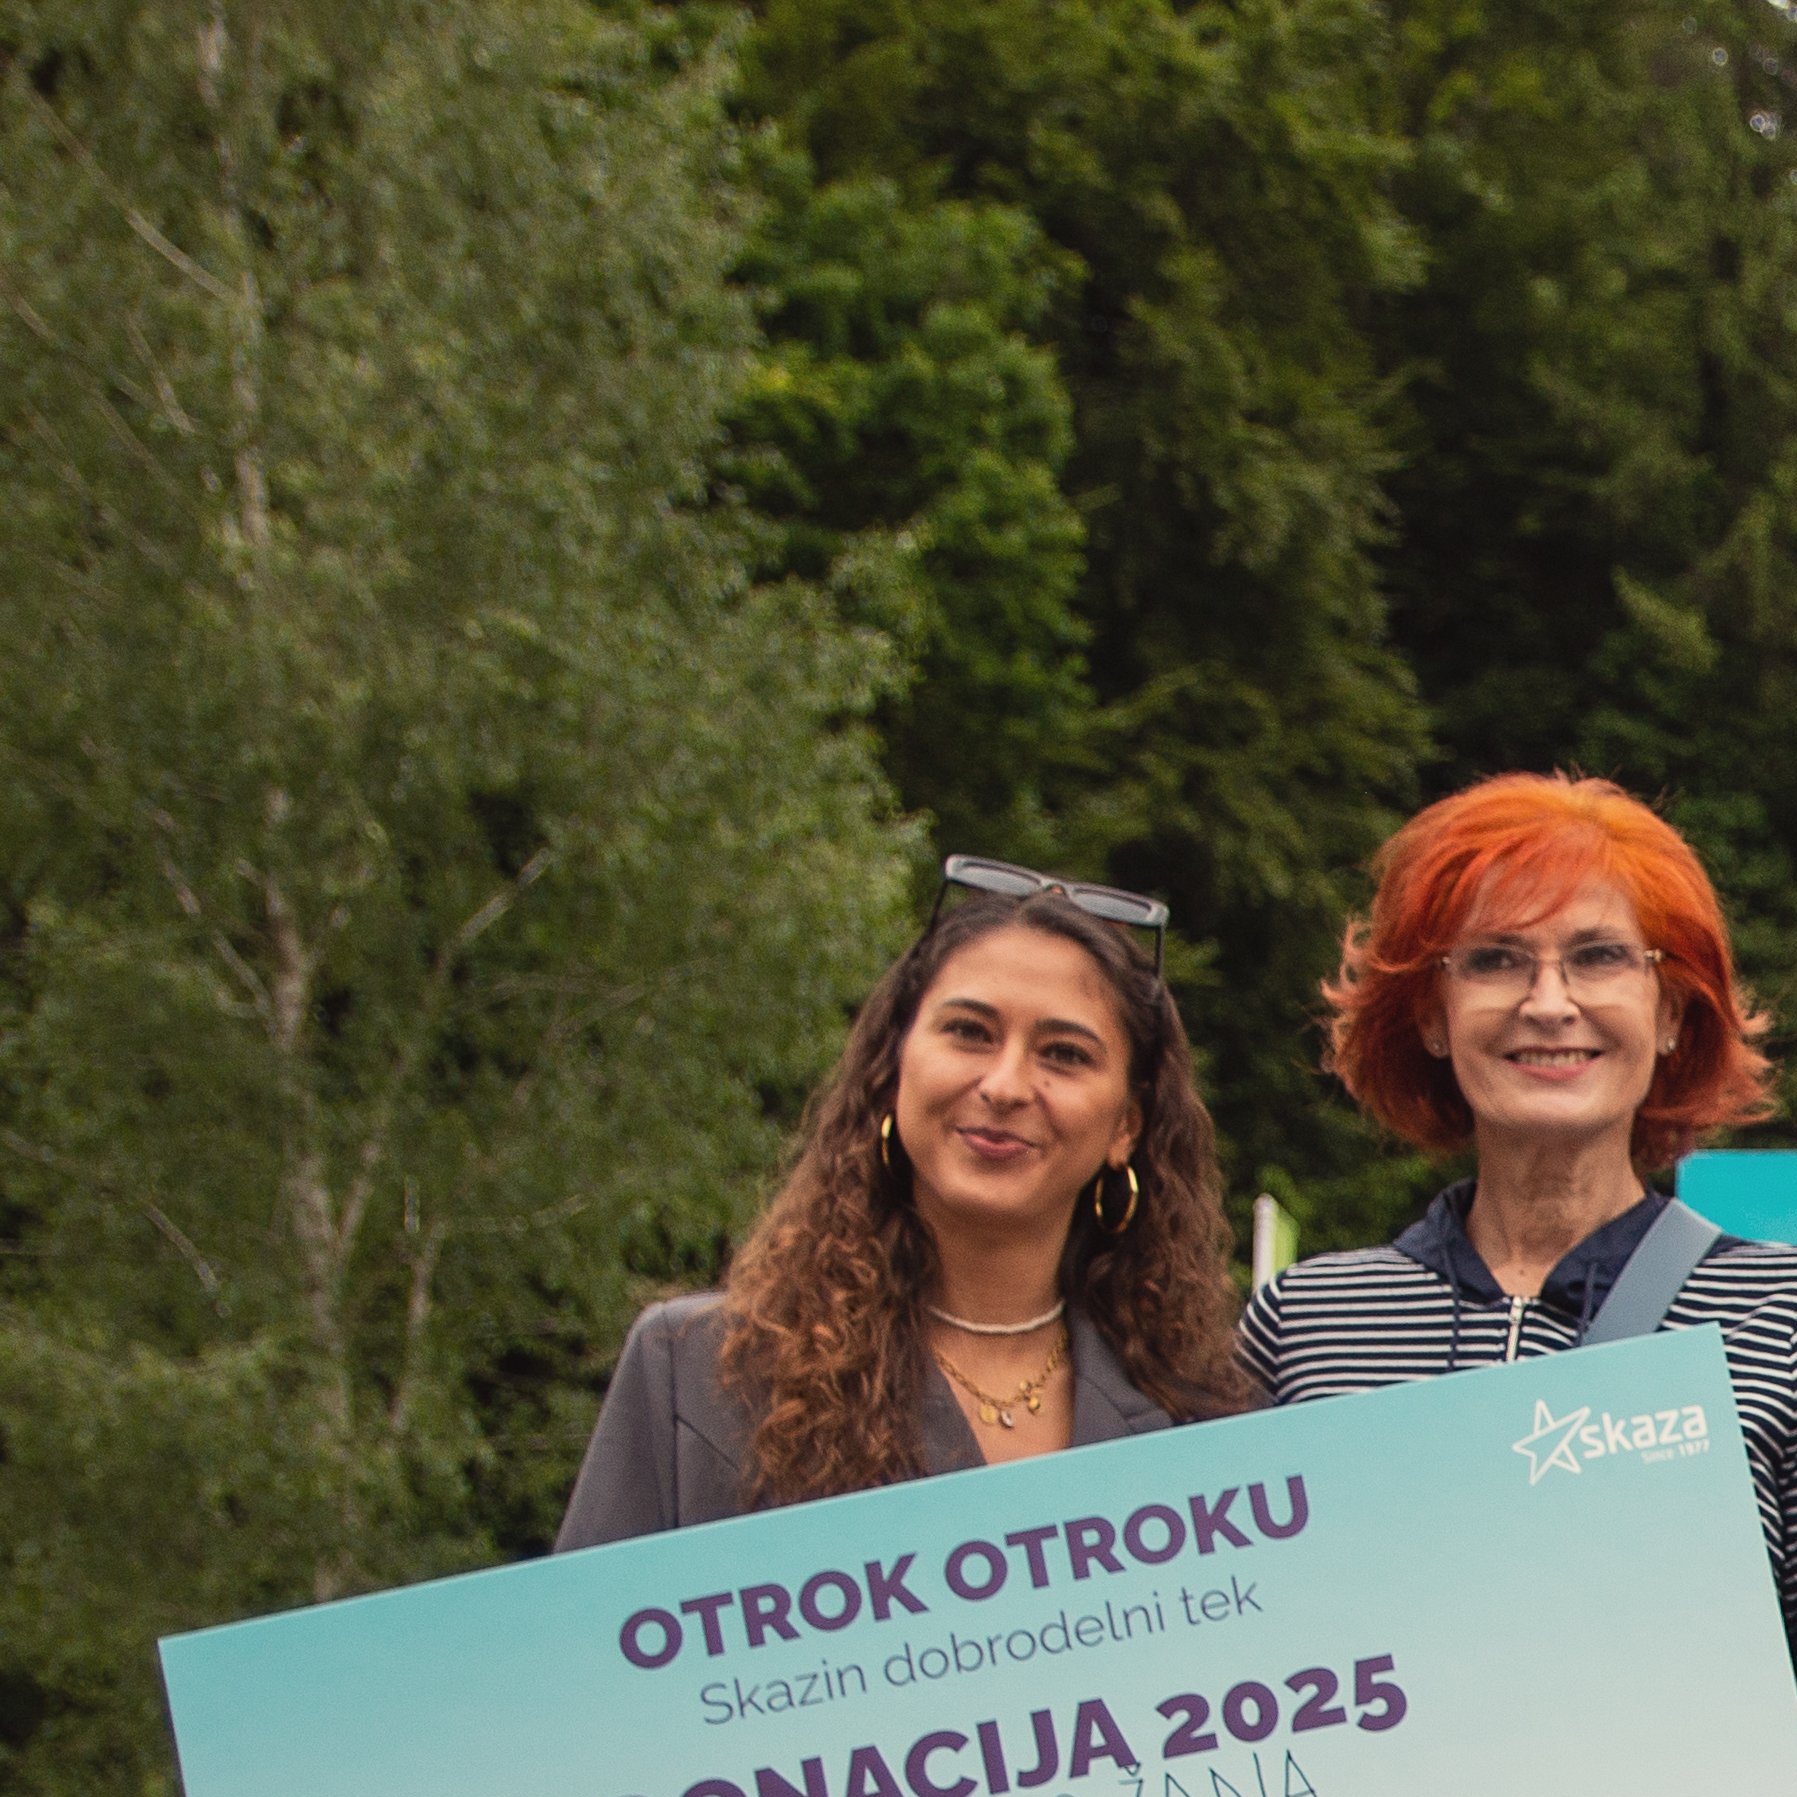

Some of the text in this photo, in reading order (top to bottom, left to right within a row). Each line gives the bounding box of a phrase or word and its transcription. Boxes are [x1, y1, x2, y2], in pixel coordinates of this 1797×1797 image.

[1579, 1404, 1709, 1459] skaza
[618, 1473, 1312, 1671] OTROK OTROKU
[699, 1575, 1264, 1725] Skazin dobrodelni tek
[1155, 1652, 1408, 1761] 2025
